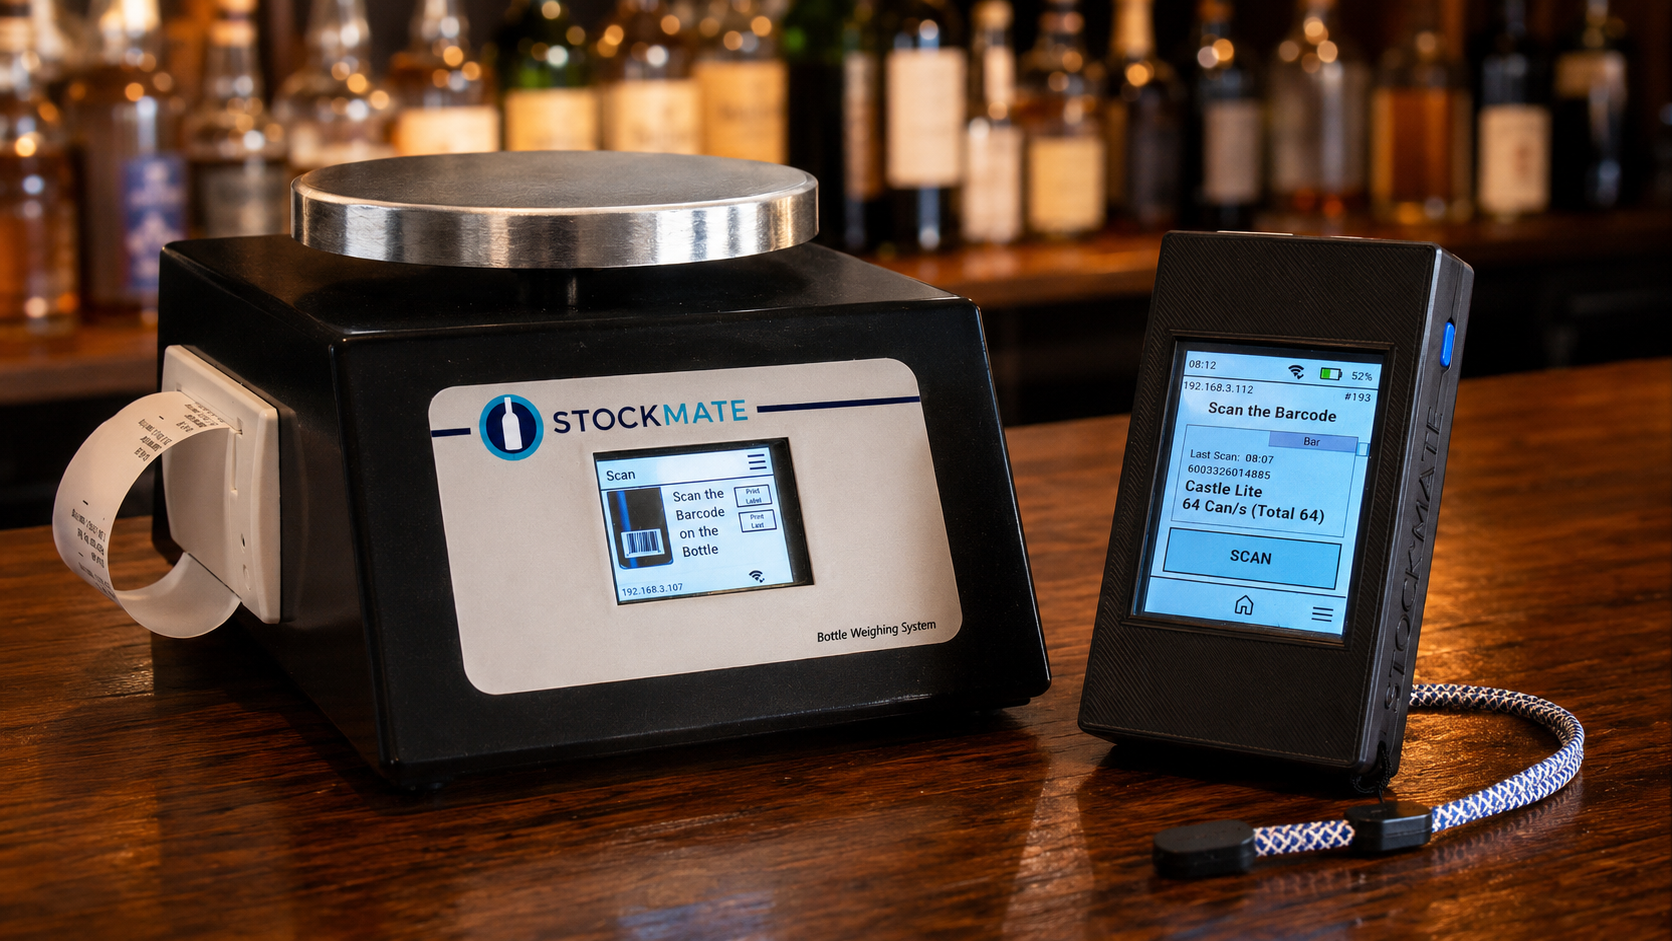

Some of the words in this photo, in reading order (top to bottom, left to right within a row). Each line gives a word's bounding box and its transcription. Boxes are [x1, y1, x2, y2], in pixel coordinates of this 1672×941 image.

[1189, 360, 1217, 370] 08:12
[1351, 371, 1373, 382] 52%
[1184, 381, 1254, 395] 192.168.3.112
[1345, 392, 1371, 403] #193
[552, 399, 749, 434] STOCKMATE
[1208, 402, 1243, 416] Scan
[1248, 405, 1271, 418] the
[1275, 406, 1337, 422] Barcode
[1304, 436, 1320, 447] Bar
[1190, 449, 1210, 460] Last
[1213, 451, 1240, 462] Scan:
[1245, 453, 1274, 464] 08:07
[606, 469, 635, 481] Scan
[1188, 464, 1271, 480] 6003326014885
[673, 491, 701, 502] Scan
[704, 488, 724, 499] the
[1185, 480, 1230, 496] Castle
[1235, 484, 1263, 498] Lite
[676, 506, 725, 521] Barcode
[1182, 498, 1200, 510] 64
[1205, 500, 1247, 516] Can/s
[1251, 503, 1295, 520] (Total
[1299, 508, 1325, 525] 64)
[679, 528, 695, 539] on
[699, 526, 719, 537] the
[682, 544, 719, 558] Bottle
[1230, 549, 1272, 565] SCAN
[622, 583, 683, 596] 192.168.3.107
[817, 628, 848, 643] Bottle
[850, 621, 899, 639] Weighing
[901, 620, 937, 636] System
